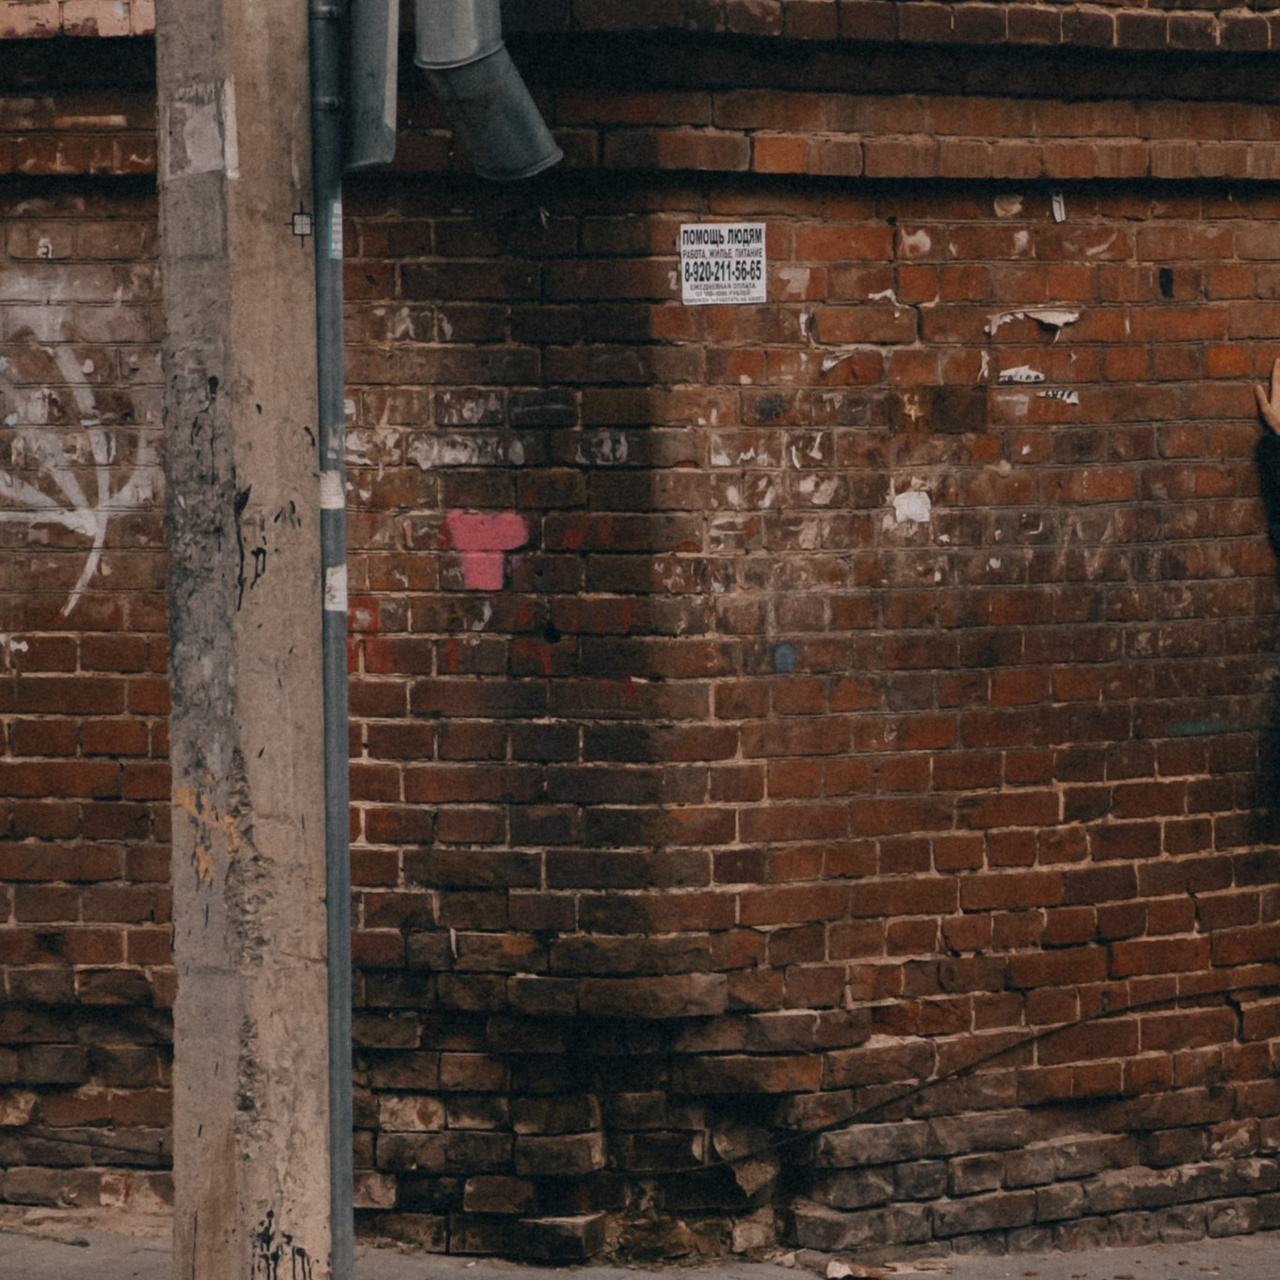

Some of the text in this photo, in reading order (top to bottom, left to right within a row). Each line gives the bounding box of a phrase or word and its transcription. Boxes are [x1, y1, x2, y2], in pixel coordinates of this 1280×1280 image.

[682, 228, 763, 248] ПОМОЩЬ ЛЮДЯМ
[682, 248, 708, 260] РАБОТА,
[735, 247, 763, 259] ПИТАНИЕ
[684, 260, 762, 282] 8-920-211-56-65
